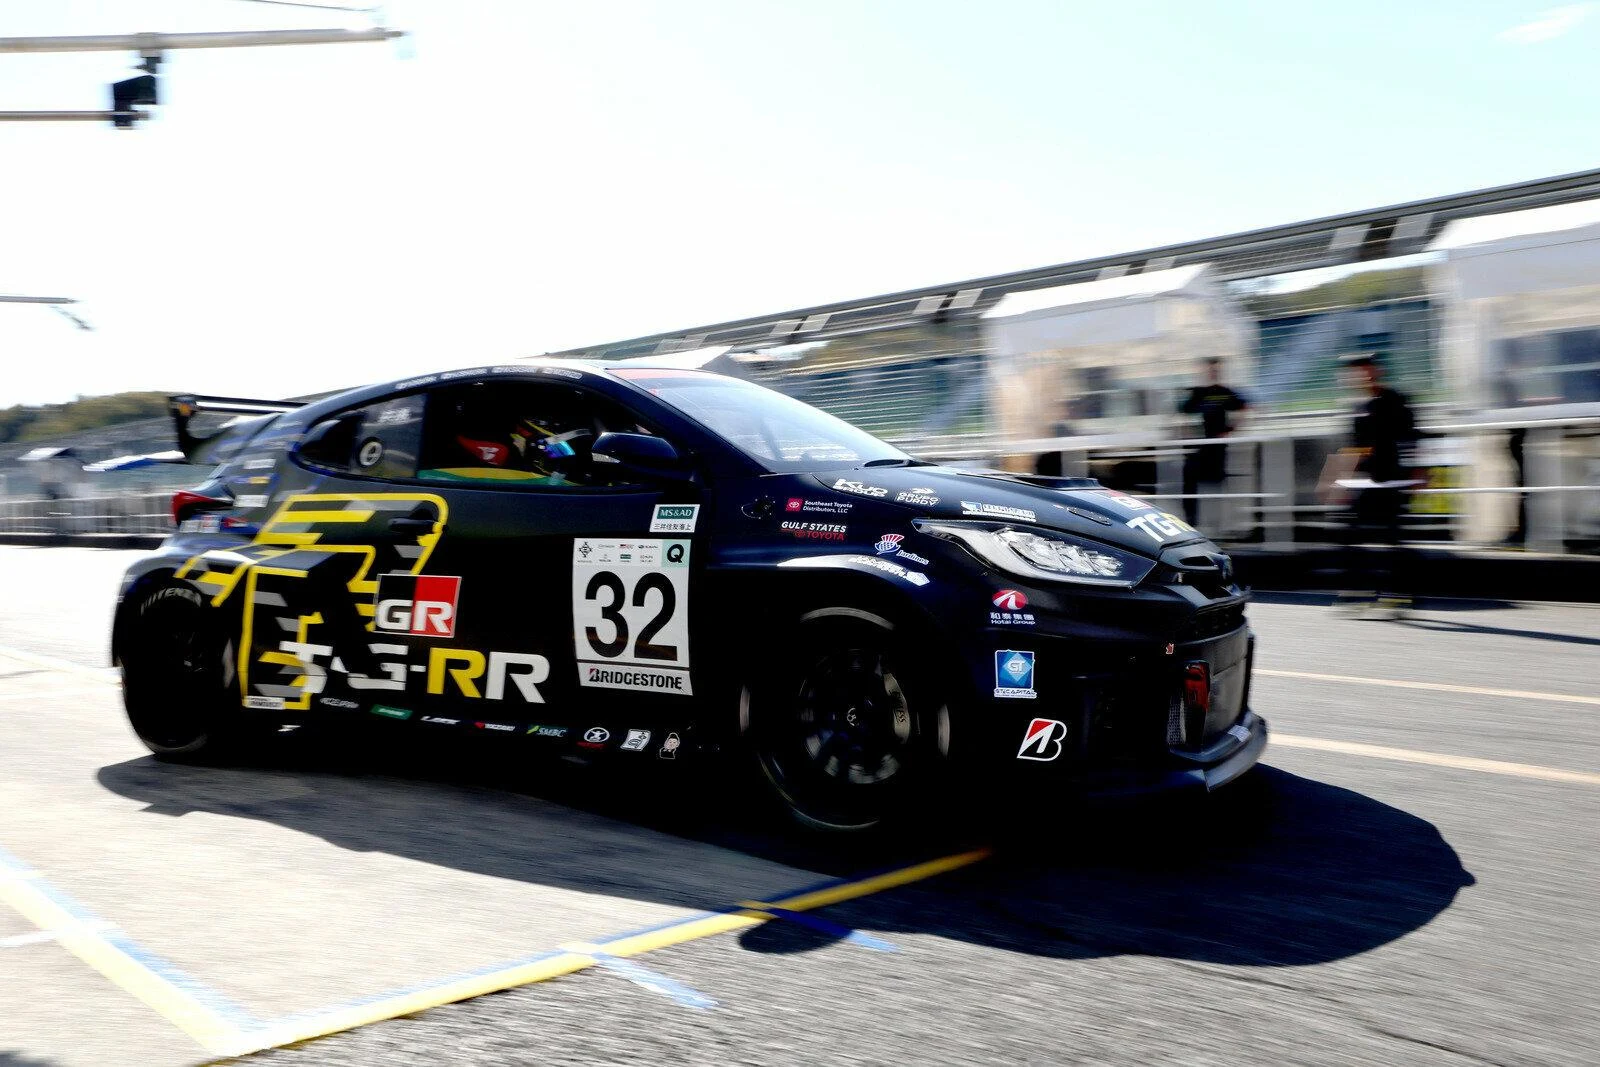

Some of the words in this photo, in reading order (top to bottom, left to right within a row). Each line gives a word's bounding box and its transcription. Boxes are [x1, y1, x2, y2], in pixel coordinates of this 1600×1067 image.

[804, 500, 832, 508] Southeast
[834, 501, 853, 509] Toyota
[660, 509, 692, 517] MS&AD
[781, 521, 808, 530] GULF
[809, 522, 847, 533] STATES
[807, 531, 845, 541] TOYOTA
[666, 543, 685, 564] Q
[376, 599, 456, 634] GR
[585, 571, 678, 661] 32
[1013, 619, 1036, 627] Group
[588, 668, 683, 690] BRIDGESTONE
